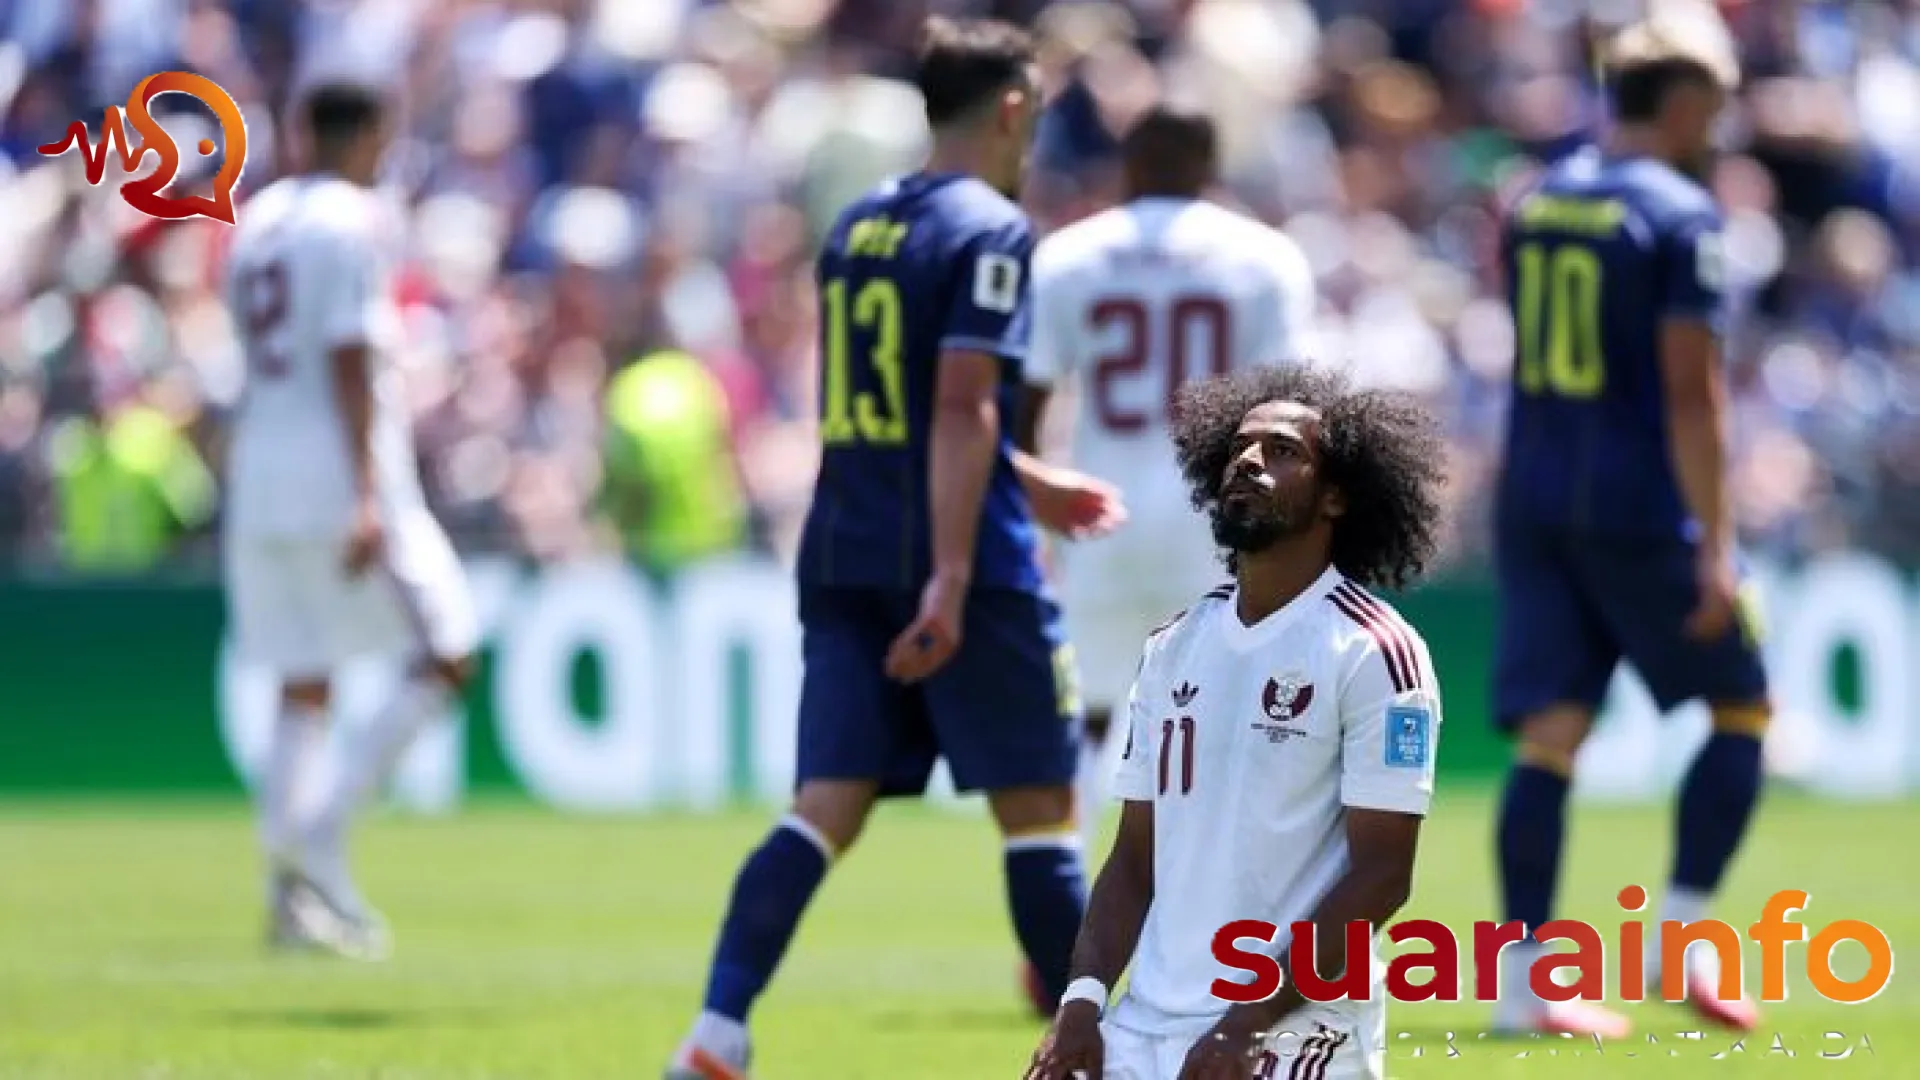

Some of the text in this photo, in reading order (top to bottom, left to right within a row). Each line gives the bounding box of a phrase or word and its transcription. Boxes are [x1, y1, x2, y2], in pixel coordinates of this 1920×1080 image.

[819, 274, 908, 446] 13
[1085, 292, 1232, 434] 20
[1520, 243, 1602, 392] 10
[1158, 716, 1195, 795] 11
